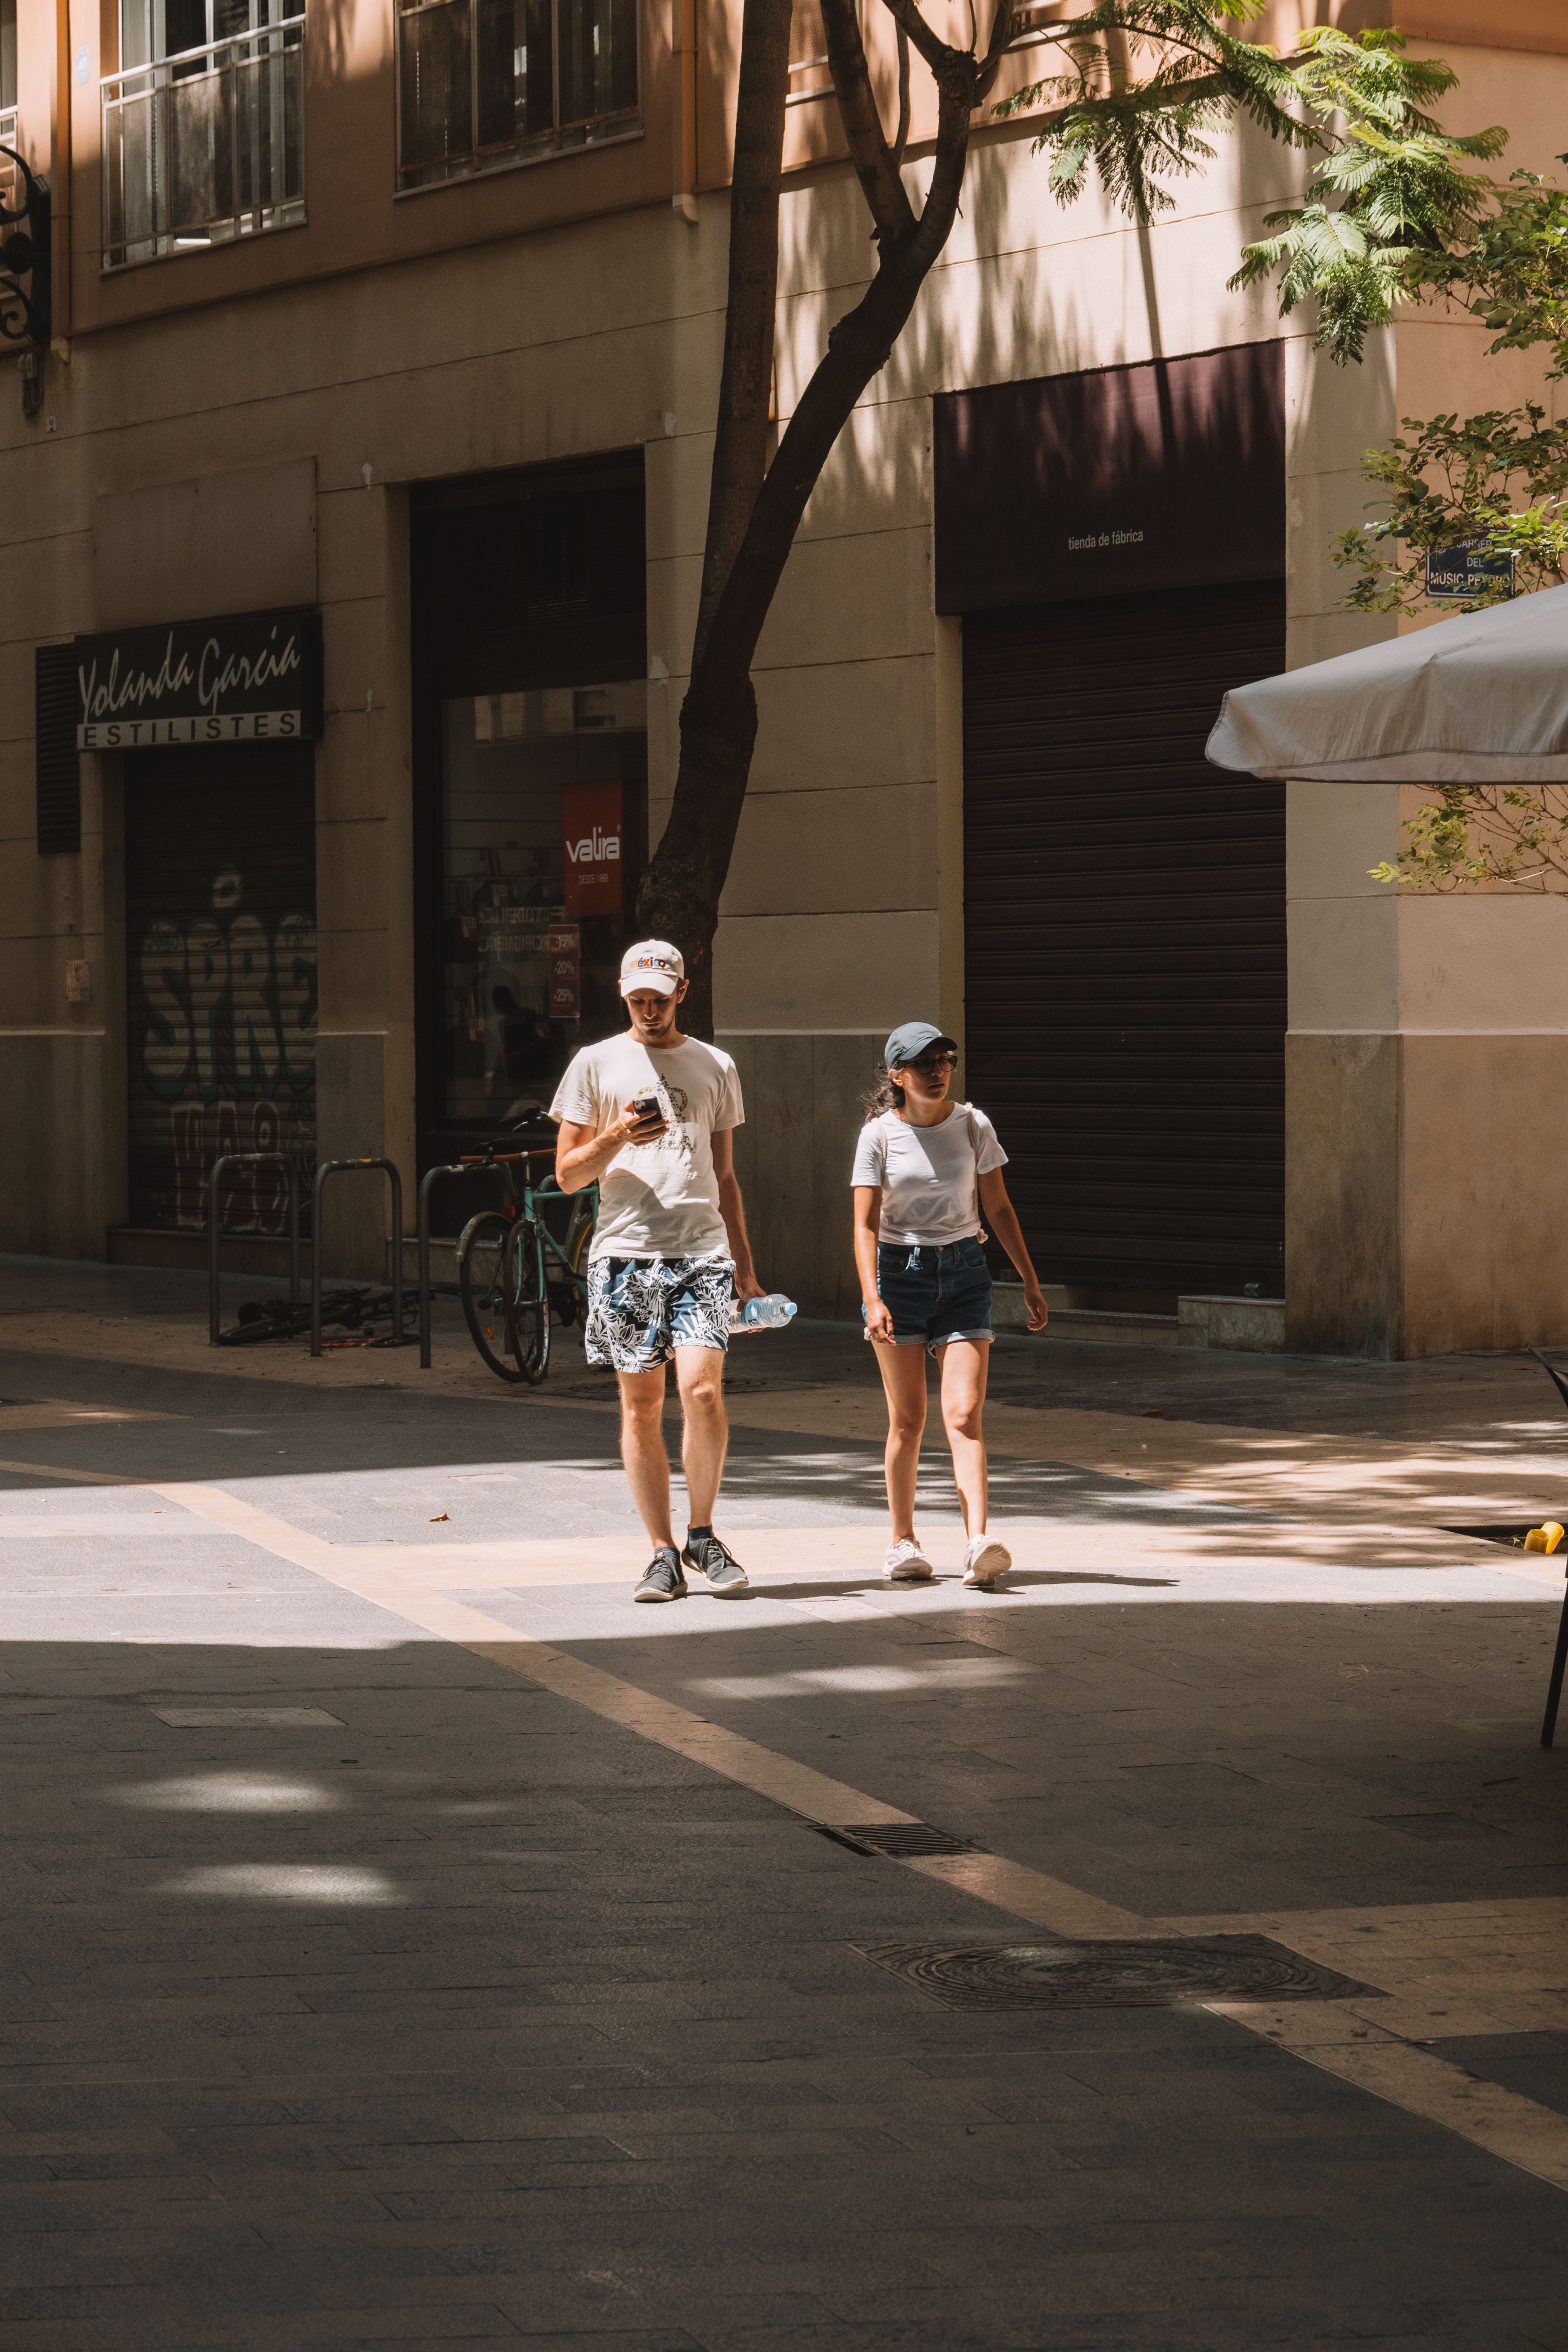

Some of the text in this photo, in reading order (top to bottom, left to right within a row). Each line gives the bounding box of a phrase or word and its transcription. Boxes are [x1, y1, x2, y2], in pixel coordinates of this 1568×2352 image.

[1068, 529, 1143, 550] tienda de fábrica
[1467, 557, 1484, 567] DEL
[78, 626, 300, 724] Yolanda García
[84, 712, 296, 747] ESTILISTES
[566, 826, 620, 863] valira
[579, 874, 596, 885] DESDE
[555, 934, 574, 948] -15%
[554, 960, 574, 974] -20%
[629, 957, 666, 969] México
[554, 988, 574, 1002] -25%
